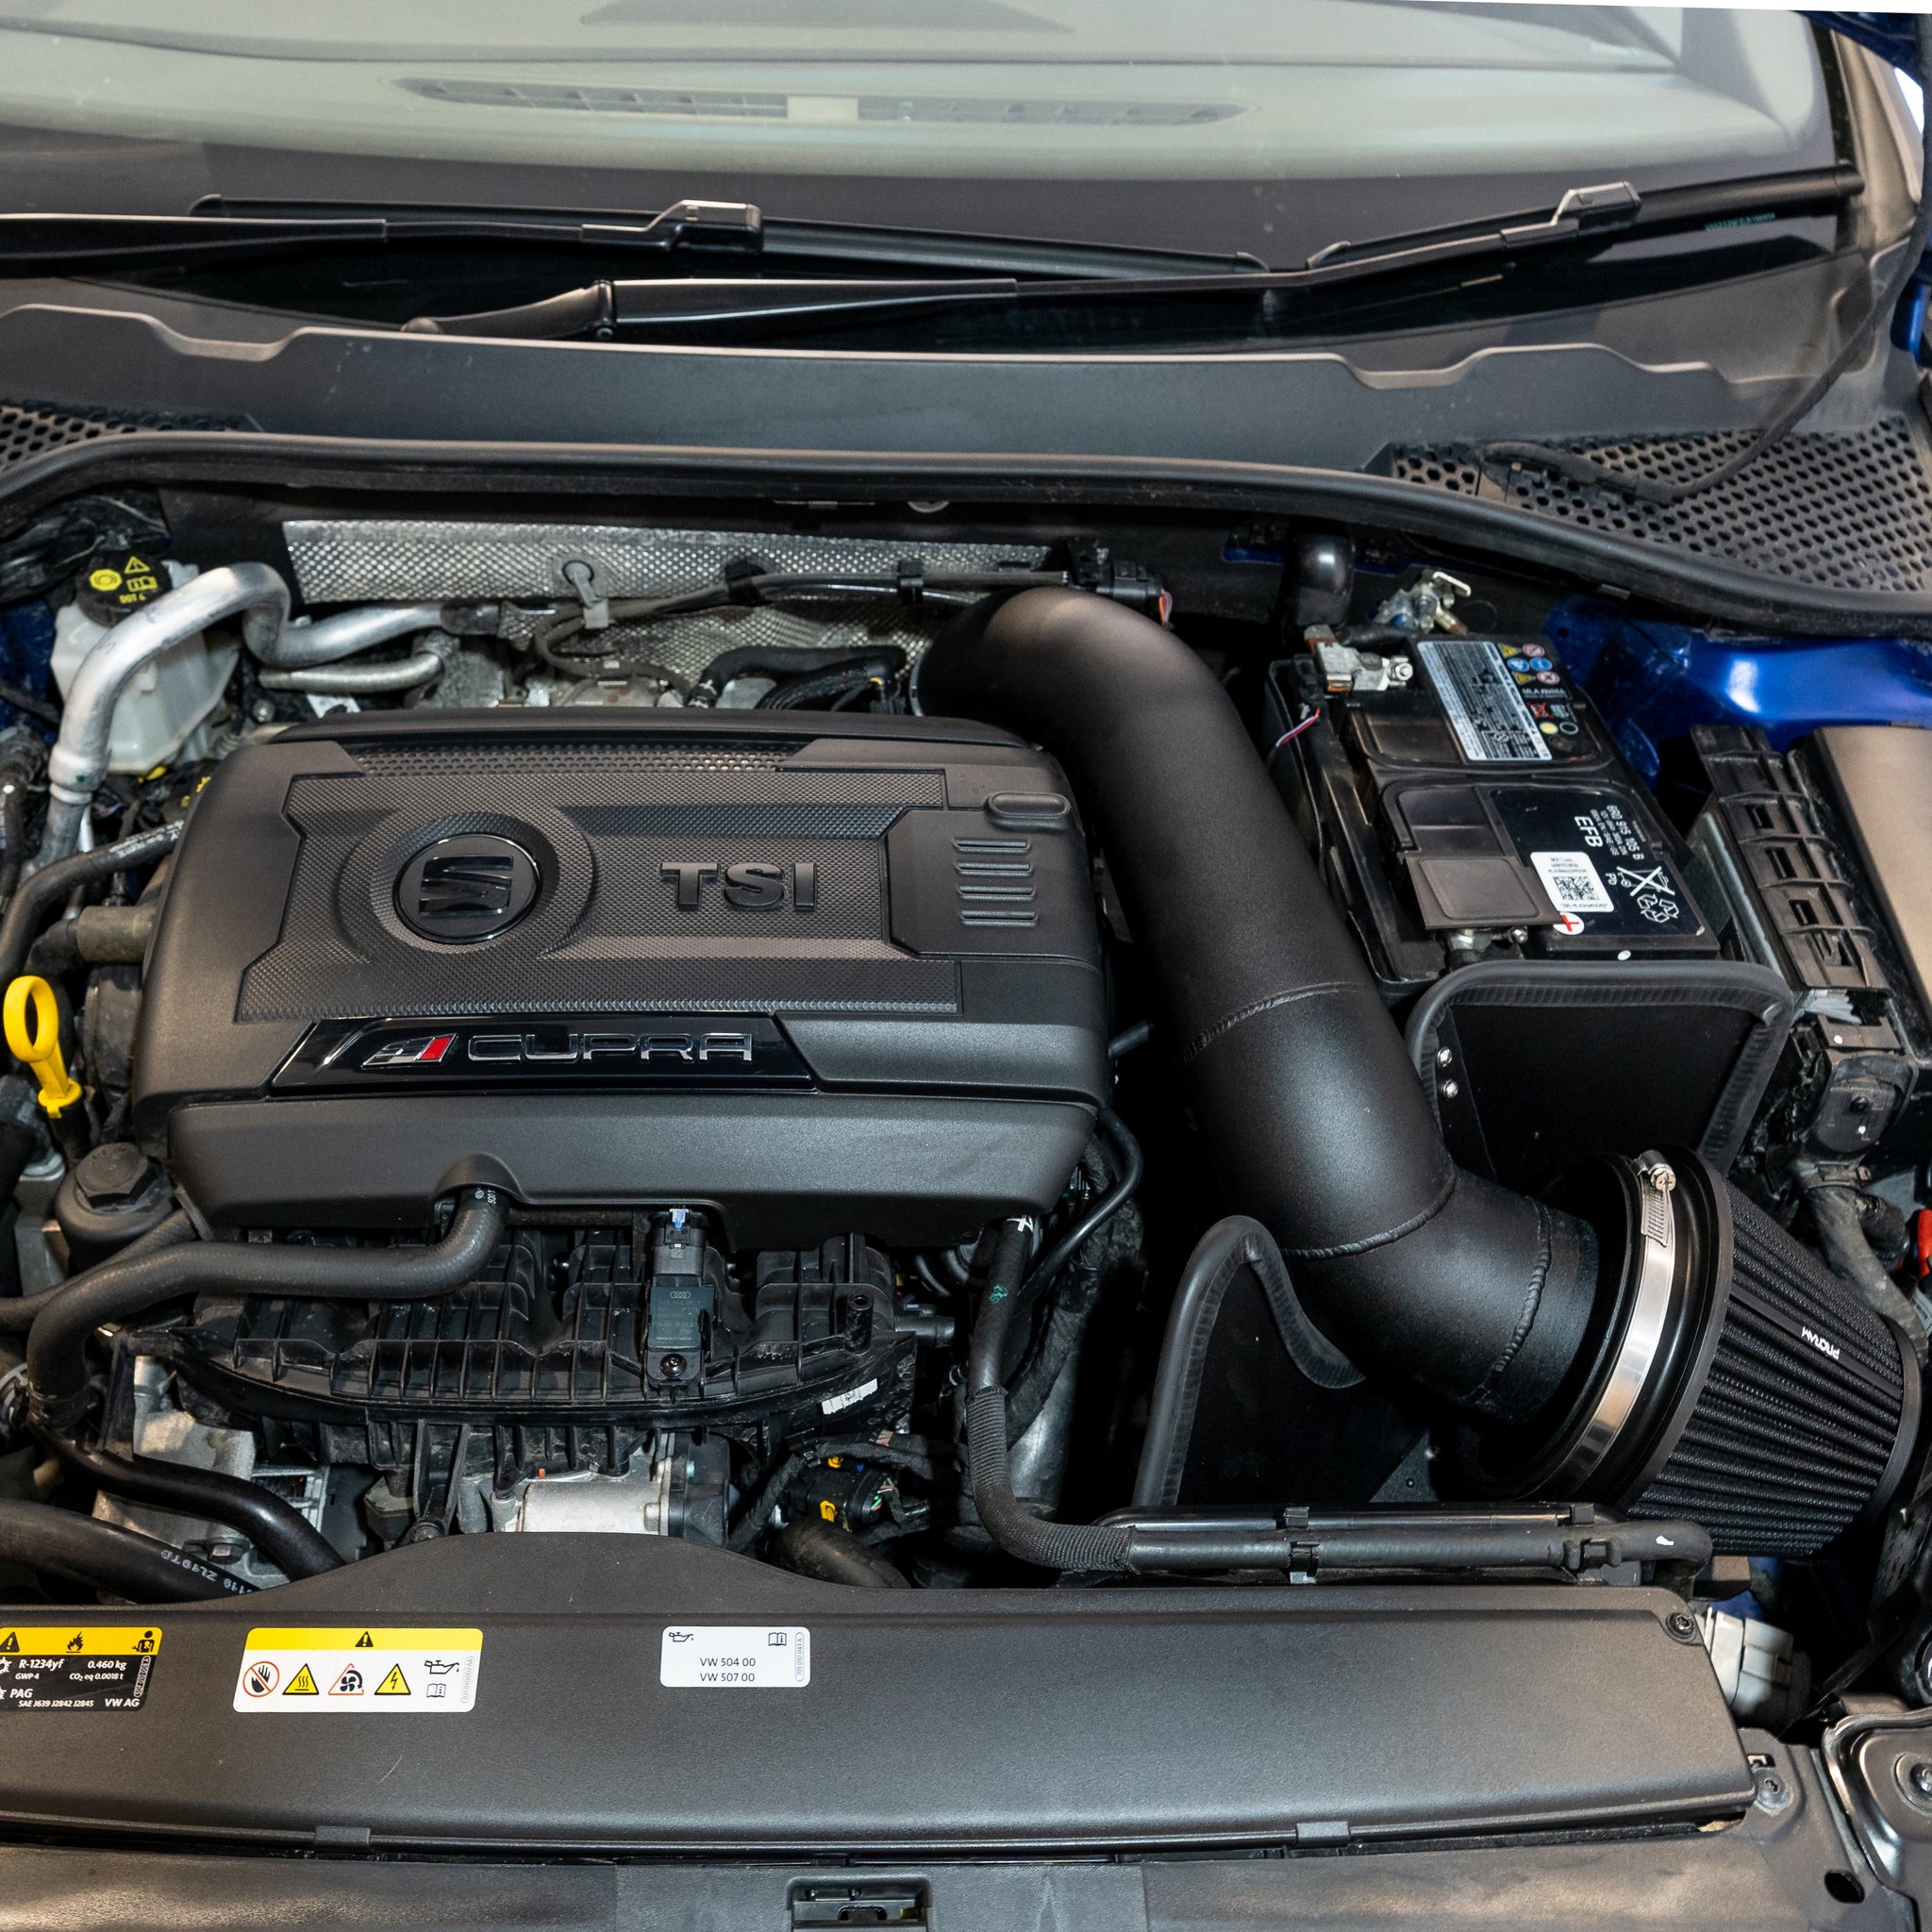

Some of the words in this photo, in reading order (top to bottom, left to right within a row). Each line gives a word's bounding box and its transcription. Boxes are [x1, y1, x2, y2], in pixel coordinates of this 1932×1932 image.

[1574, 816, 1603, 847] EFB
[661, 861, 818, 911] TSI
[468, 1032, 752, 1063] CUPRA
[19, 1658, 65, 1671] R-1234yf
[88, 1660, 114, 1669] 0.460
[115, 1660, 127, 1671] kg
[700, 1657, 718, 1666] VW
[721, 1657, 740, 1666] 504
[741, 1657, 756, 1666] 00
[700, 1673, 718, 1681] VW
[721, 1673, 739, 1681] 507
[741, 1673, 756, 1681] 00
[9, 1688, 33, 1698] PAG
[18, 1699, 33, 1707] SAE
[105, 1698, 123, 1707] VW
[124, 1698, 141, 1707] AG
